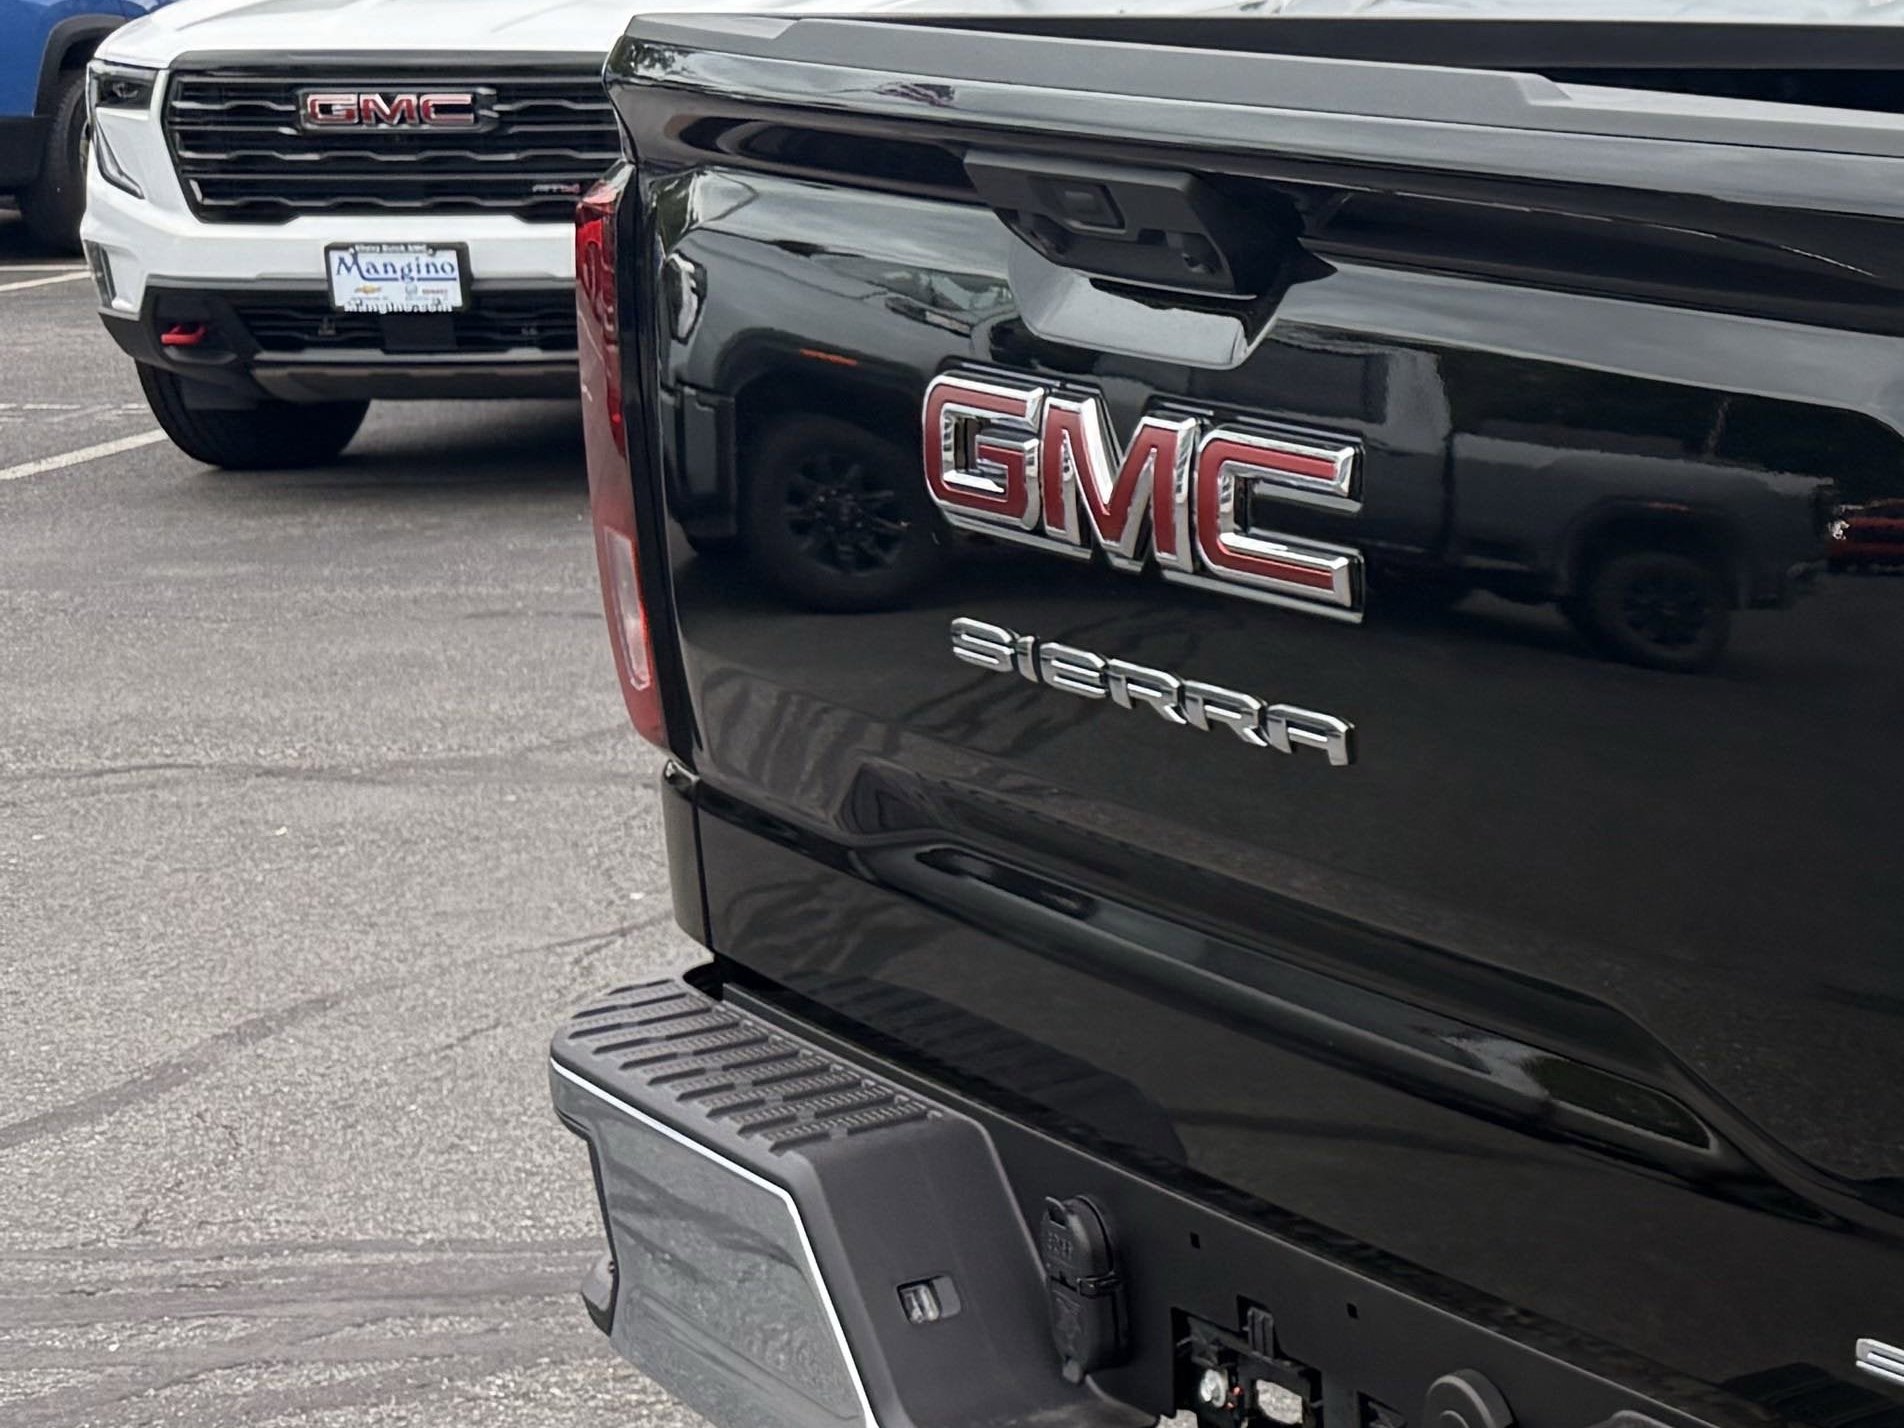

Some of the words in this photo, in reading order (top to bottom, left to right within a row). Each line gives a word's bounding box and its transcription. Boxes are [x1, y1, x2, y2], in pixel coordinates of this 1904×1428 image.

[305, 93, 475, 125] GMC
[336, 252, 457, 283] Mangino
[922, 370, 1362, 618] GMC
[951, 617, 1356, 766] SIERRA
